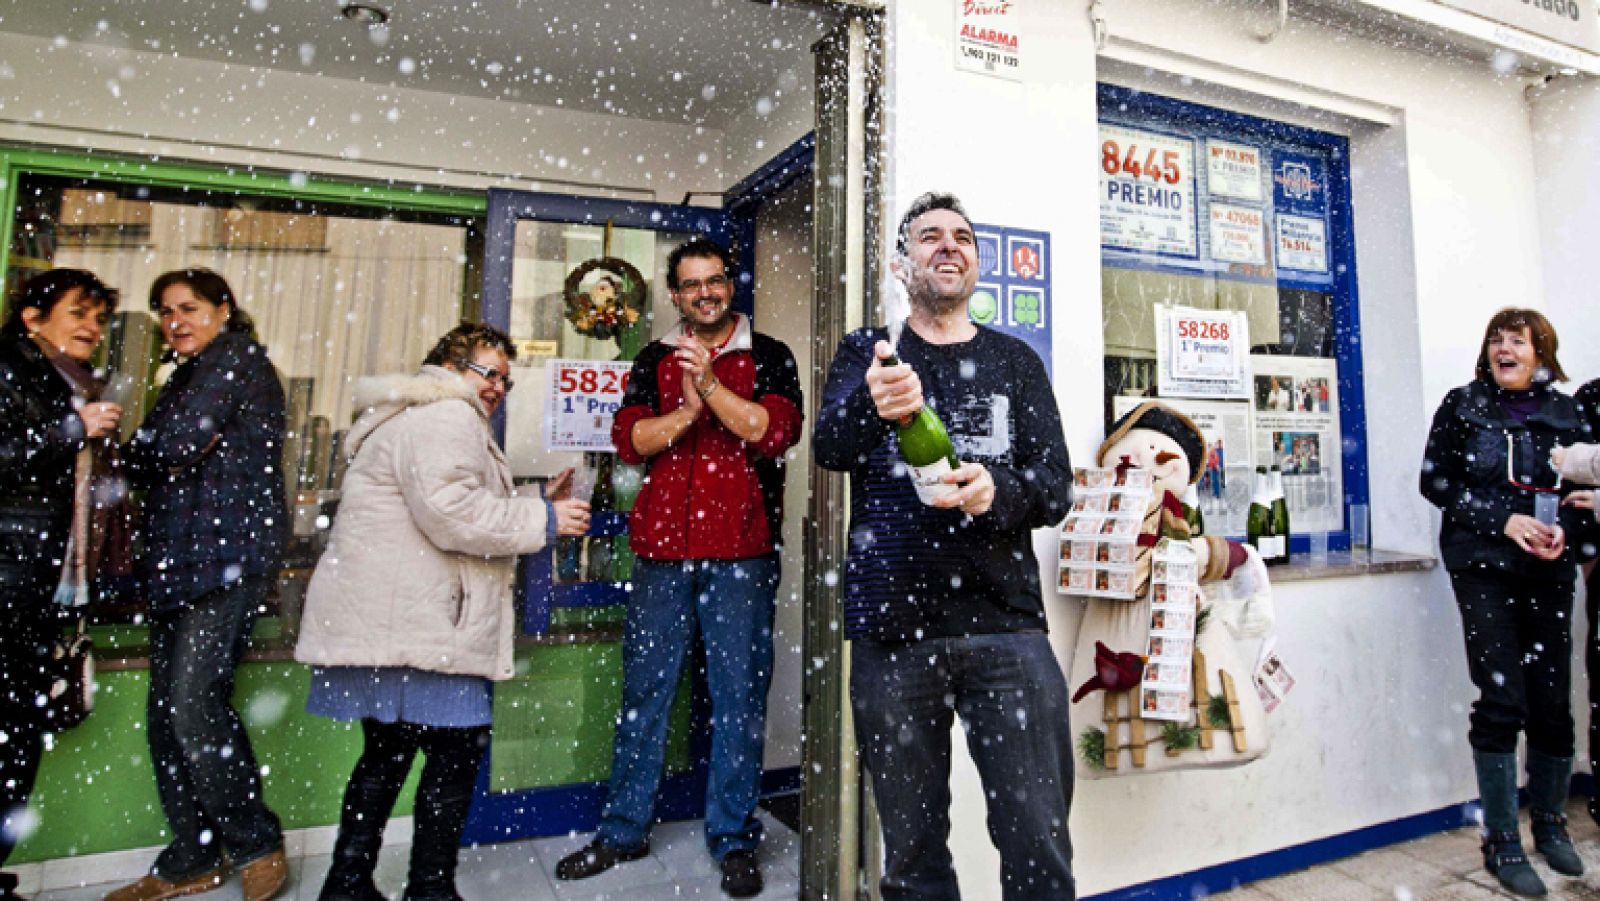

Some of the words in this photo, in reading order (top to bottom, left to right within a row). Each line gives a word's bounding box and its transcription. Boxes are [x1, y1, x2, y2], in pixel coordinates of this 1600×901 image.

[960, 23, 1018, 48] ALARMA
[1102, 140, 1181, 185] 8445
[1107, 180, 1182, 211] PREMIO
[1179, 320, 1230, 340] 58268
[1193, 341, 1230, 354] Premio
